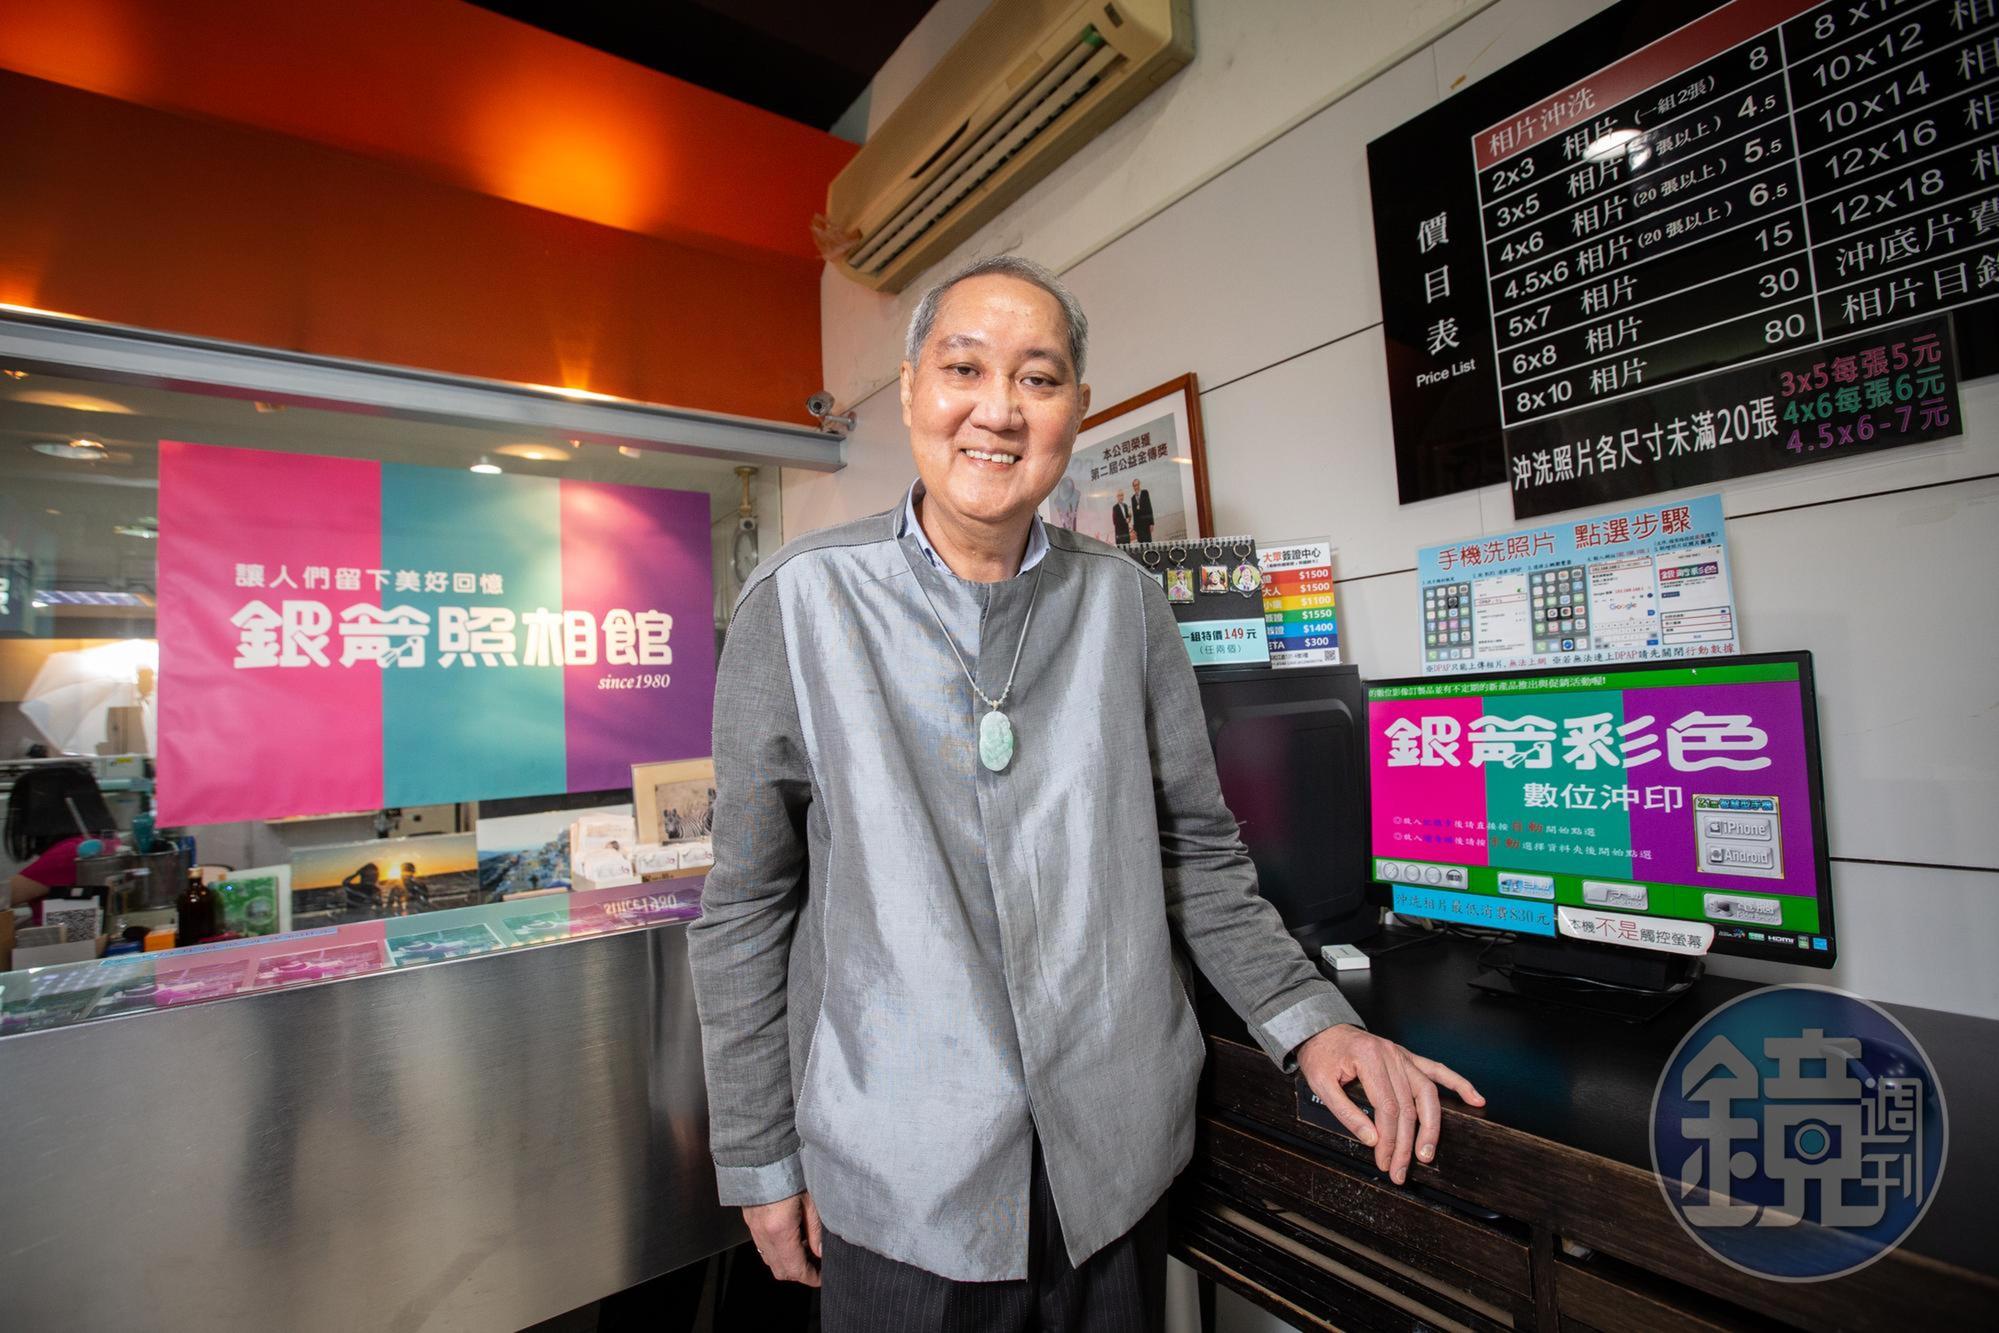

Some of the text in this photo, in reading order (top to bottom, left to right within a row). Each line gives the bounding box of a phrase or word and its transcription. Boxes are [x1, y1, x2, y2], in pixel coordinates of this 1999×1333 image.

[1812, 22, 1924, 88] 10x12
[1488, 87, 1596, 157] 相片沖洗
[1492, 157, 1536, 192] 2x3
[1750, 46, 1768, 71] 8
[1819, 70, 1930, 133] 10x14
[1497, 193, 1540, 227] 3x5
[1567, 158, 1623, 199] 相片
[1737, 95, 1776, 119] 4.5
[1824, 119, 1938, 180] 12x16
[1500, 231, 1544, 263] 4x6
[1571, 195, 1628, 237] 相片
[1744, 137, 1782, 164] 5.5
[1831, 168, 1944, 226] 12x18
[1504, 261, 1569, 300] 4.5x6
[1576, 235, 1633, 276] 相片
[1750, 182, 1788, 207] 6.5
[1416, 211, 1460, 356] 價目表
[1508, 221, 1793, 337] 5x7 相片 15
[1512, 267, 1800, 375] 6x8 相片 30
[1416, 358, 1476, 388] Price List
[1516, 313, 1805, 413] 8x10 相片 80
[1780, 332, 1942, 398] 3x5每張5元
[1782, 365, 1946, 425] 4x6每張6元
[1103, 432, 1151, 461] 本公司榮獲
[1512, 395, 1779, 491] 沖洗照片各尺寸未滿20張
[1437, 506, 1692, 571] 手機洗照片 點選步驟
[234, 562, 505, 597] 讓人們留下美好回憶
[1299, 569, 1329, 580] $1500
[1300, 582, 1330, 593] $1500
[1301, 596, 1331, 606] $1100
[1302, 609, 1332, 620] $1550
[1303, 622, 1333, 633] $1400
[1304, 637, 1329, 647] $300
[1522, 782, 1684, 814] 數位沖印
[1722, 820, 1767, 836] iPhone
[1725, 849, 1768, 865] Android
